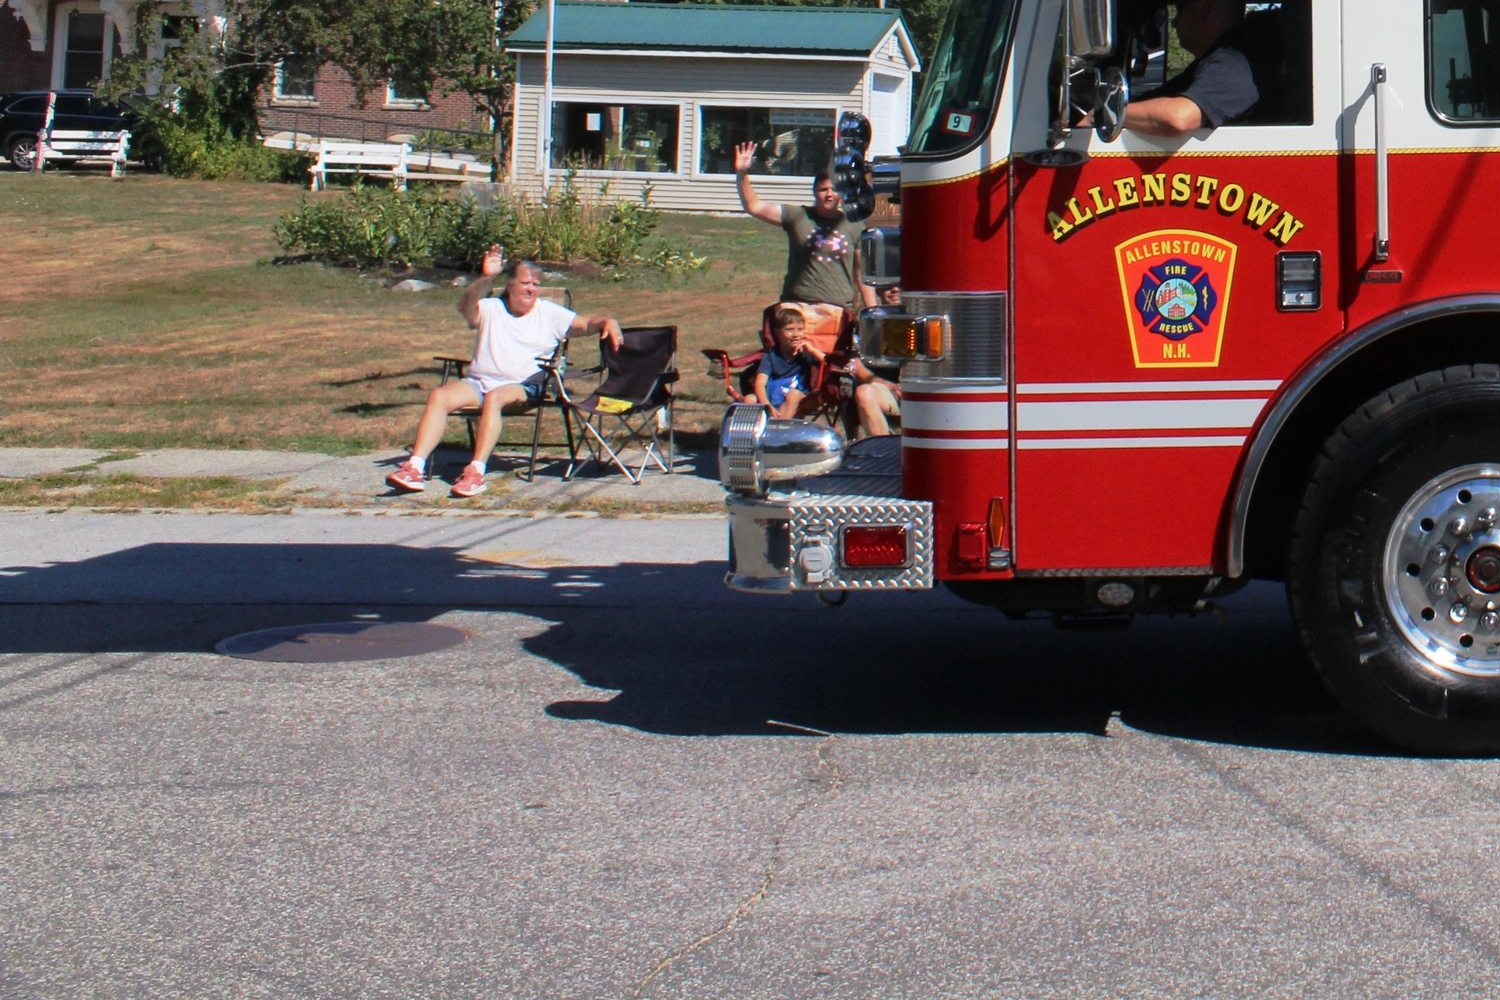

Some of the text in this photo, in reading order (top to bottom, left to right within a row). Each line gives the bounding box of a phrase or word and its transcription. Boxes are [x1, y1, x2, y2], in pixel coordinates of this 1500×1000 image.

[952, 115, 961, 129] 9
[1047, 172, 1304, 246] ALLENSTOWN
[1125, 240, 1226, 265] ALLENSTOWN
[1165, 265, 1188, 275] FIRE
[1159, 322, 1195, 334] RESCUE
[1163, 343, 1191, 359] N.H.
